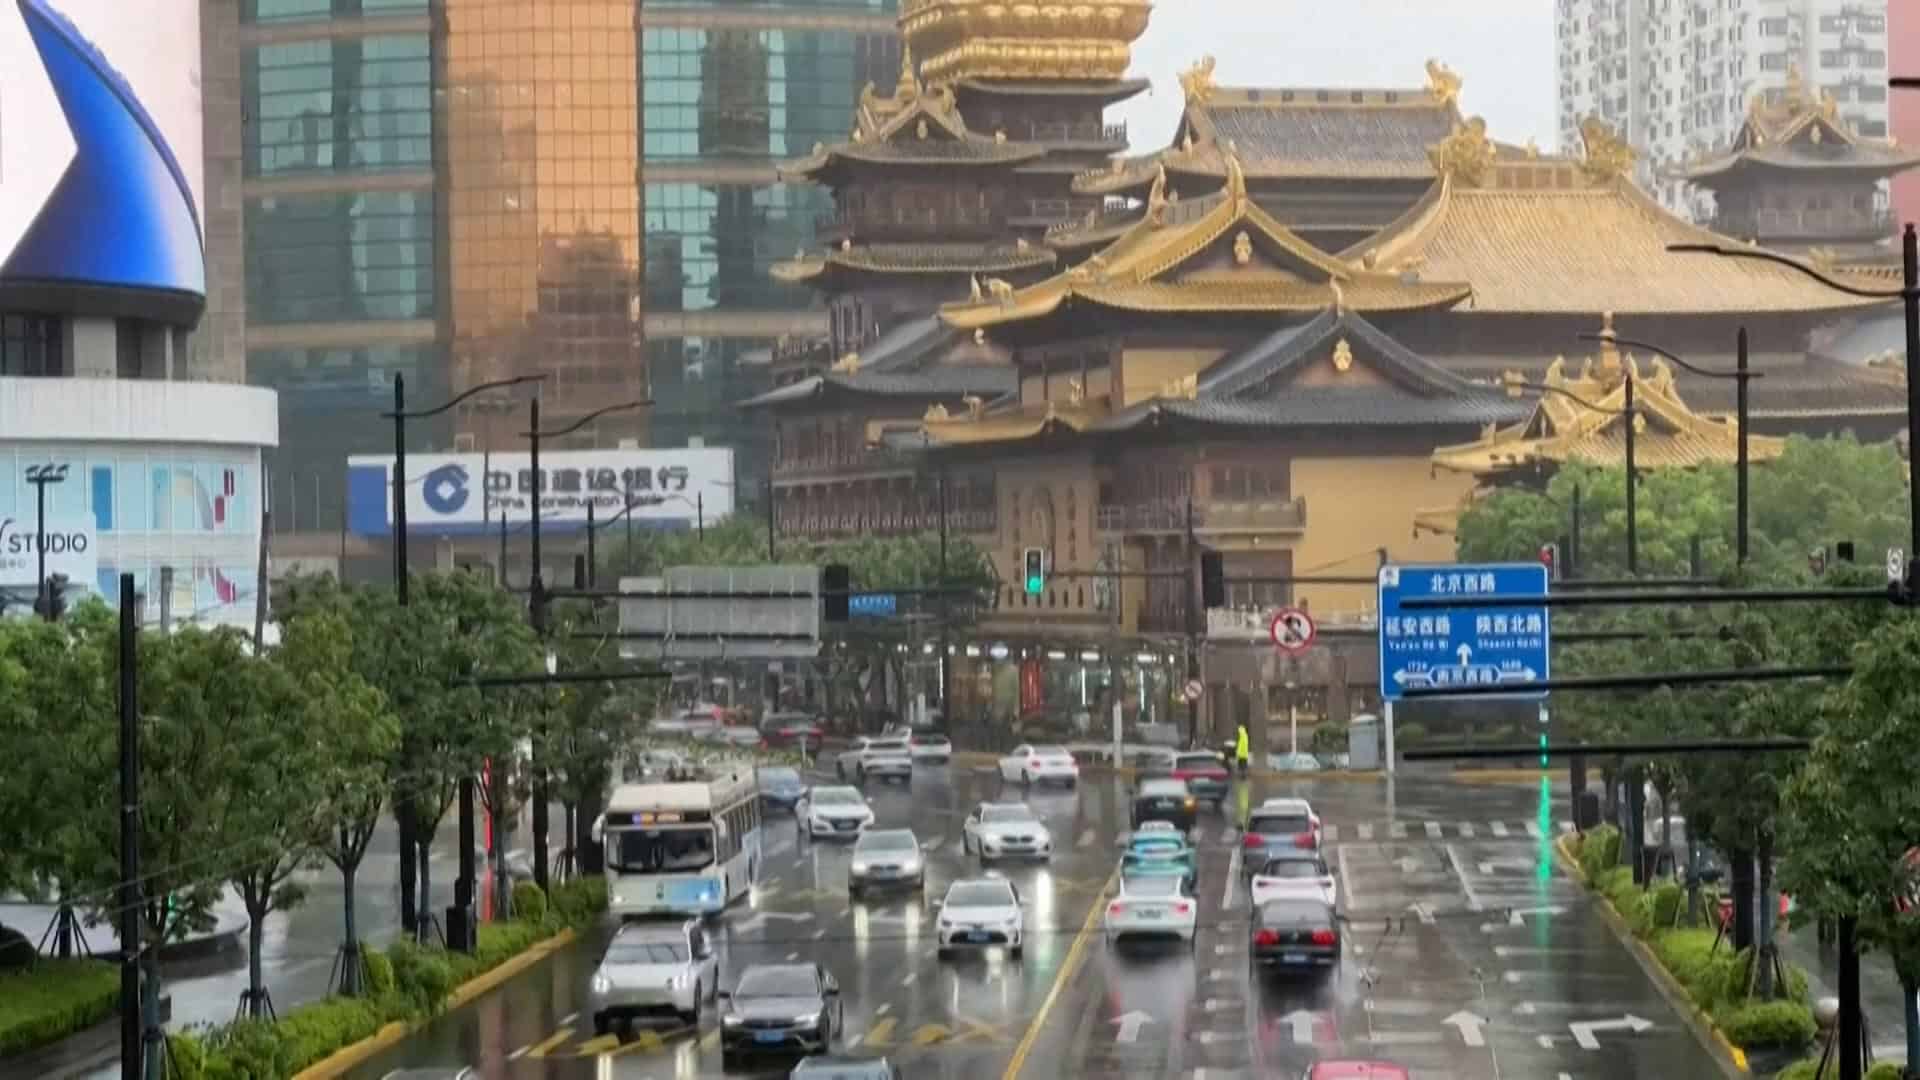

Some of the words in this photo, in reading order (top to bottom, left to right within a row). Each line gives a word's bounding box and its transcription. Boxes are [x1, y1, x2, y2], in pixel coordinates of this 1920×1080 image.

[484, 466, 689, 493] 中国建设银行
[8, 532, 87, 553] STUDIO
[1431, 573, 1496, 593] 北京西路
